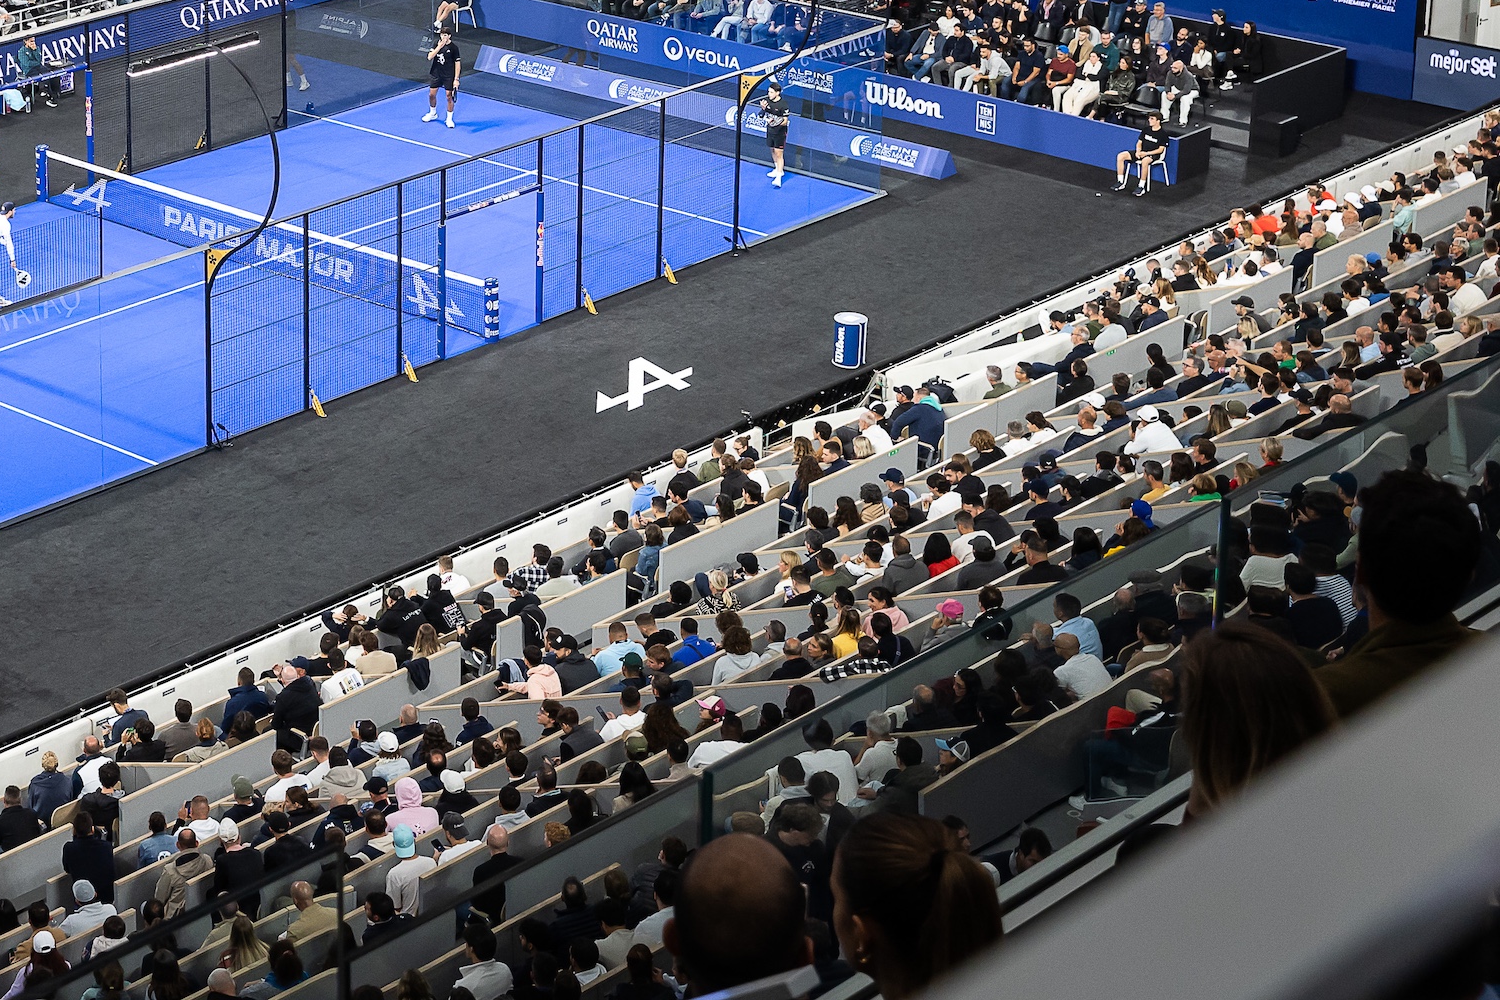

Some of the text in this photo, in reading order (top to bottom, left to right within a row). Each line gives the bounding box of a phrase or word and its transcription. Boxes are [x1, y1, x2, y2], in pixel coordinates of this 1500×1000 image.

[1371, 2, 1396, 13] PADEL
[587, 19, 638, 43] QATAR
[41, 22, 128, 66] AIRWAYS
[598, 37, 639, 54] AIRWAYS
[518, 59, 557, 72] ALPINE
[685, 46, 741, 71] VEOLIA
[517, 64, 535, 75] PARIS
[789, 66, 834, 82] ALPINE
[864, 80, 943, 119] Wilson
[979, 105, 993, 117] TEN
[979, 118, 992, 130] NIS
[872, 146, 918, 164] PARIS MAJOR
[874, 142, 920, 157] ALPINE
[163, 205, 355, 284] PARIS MAJOR
